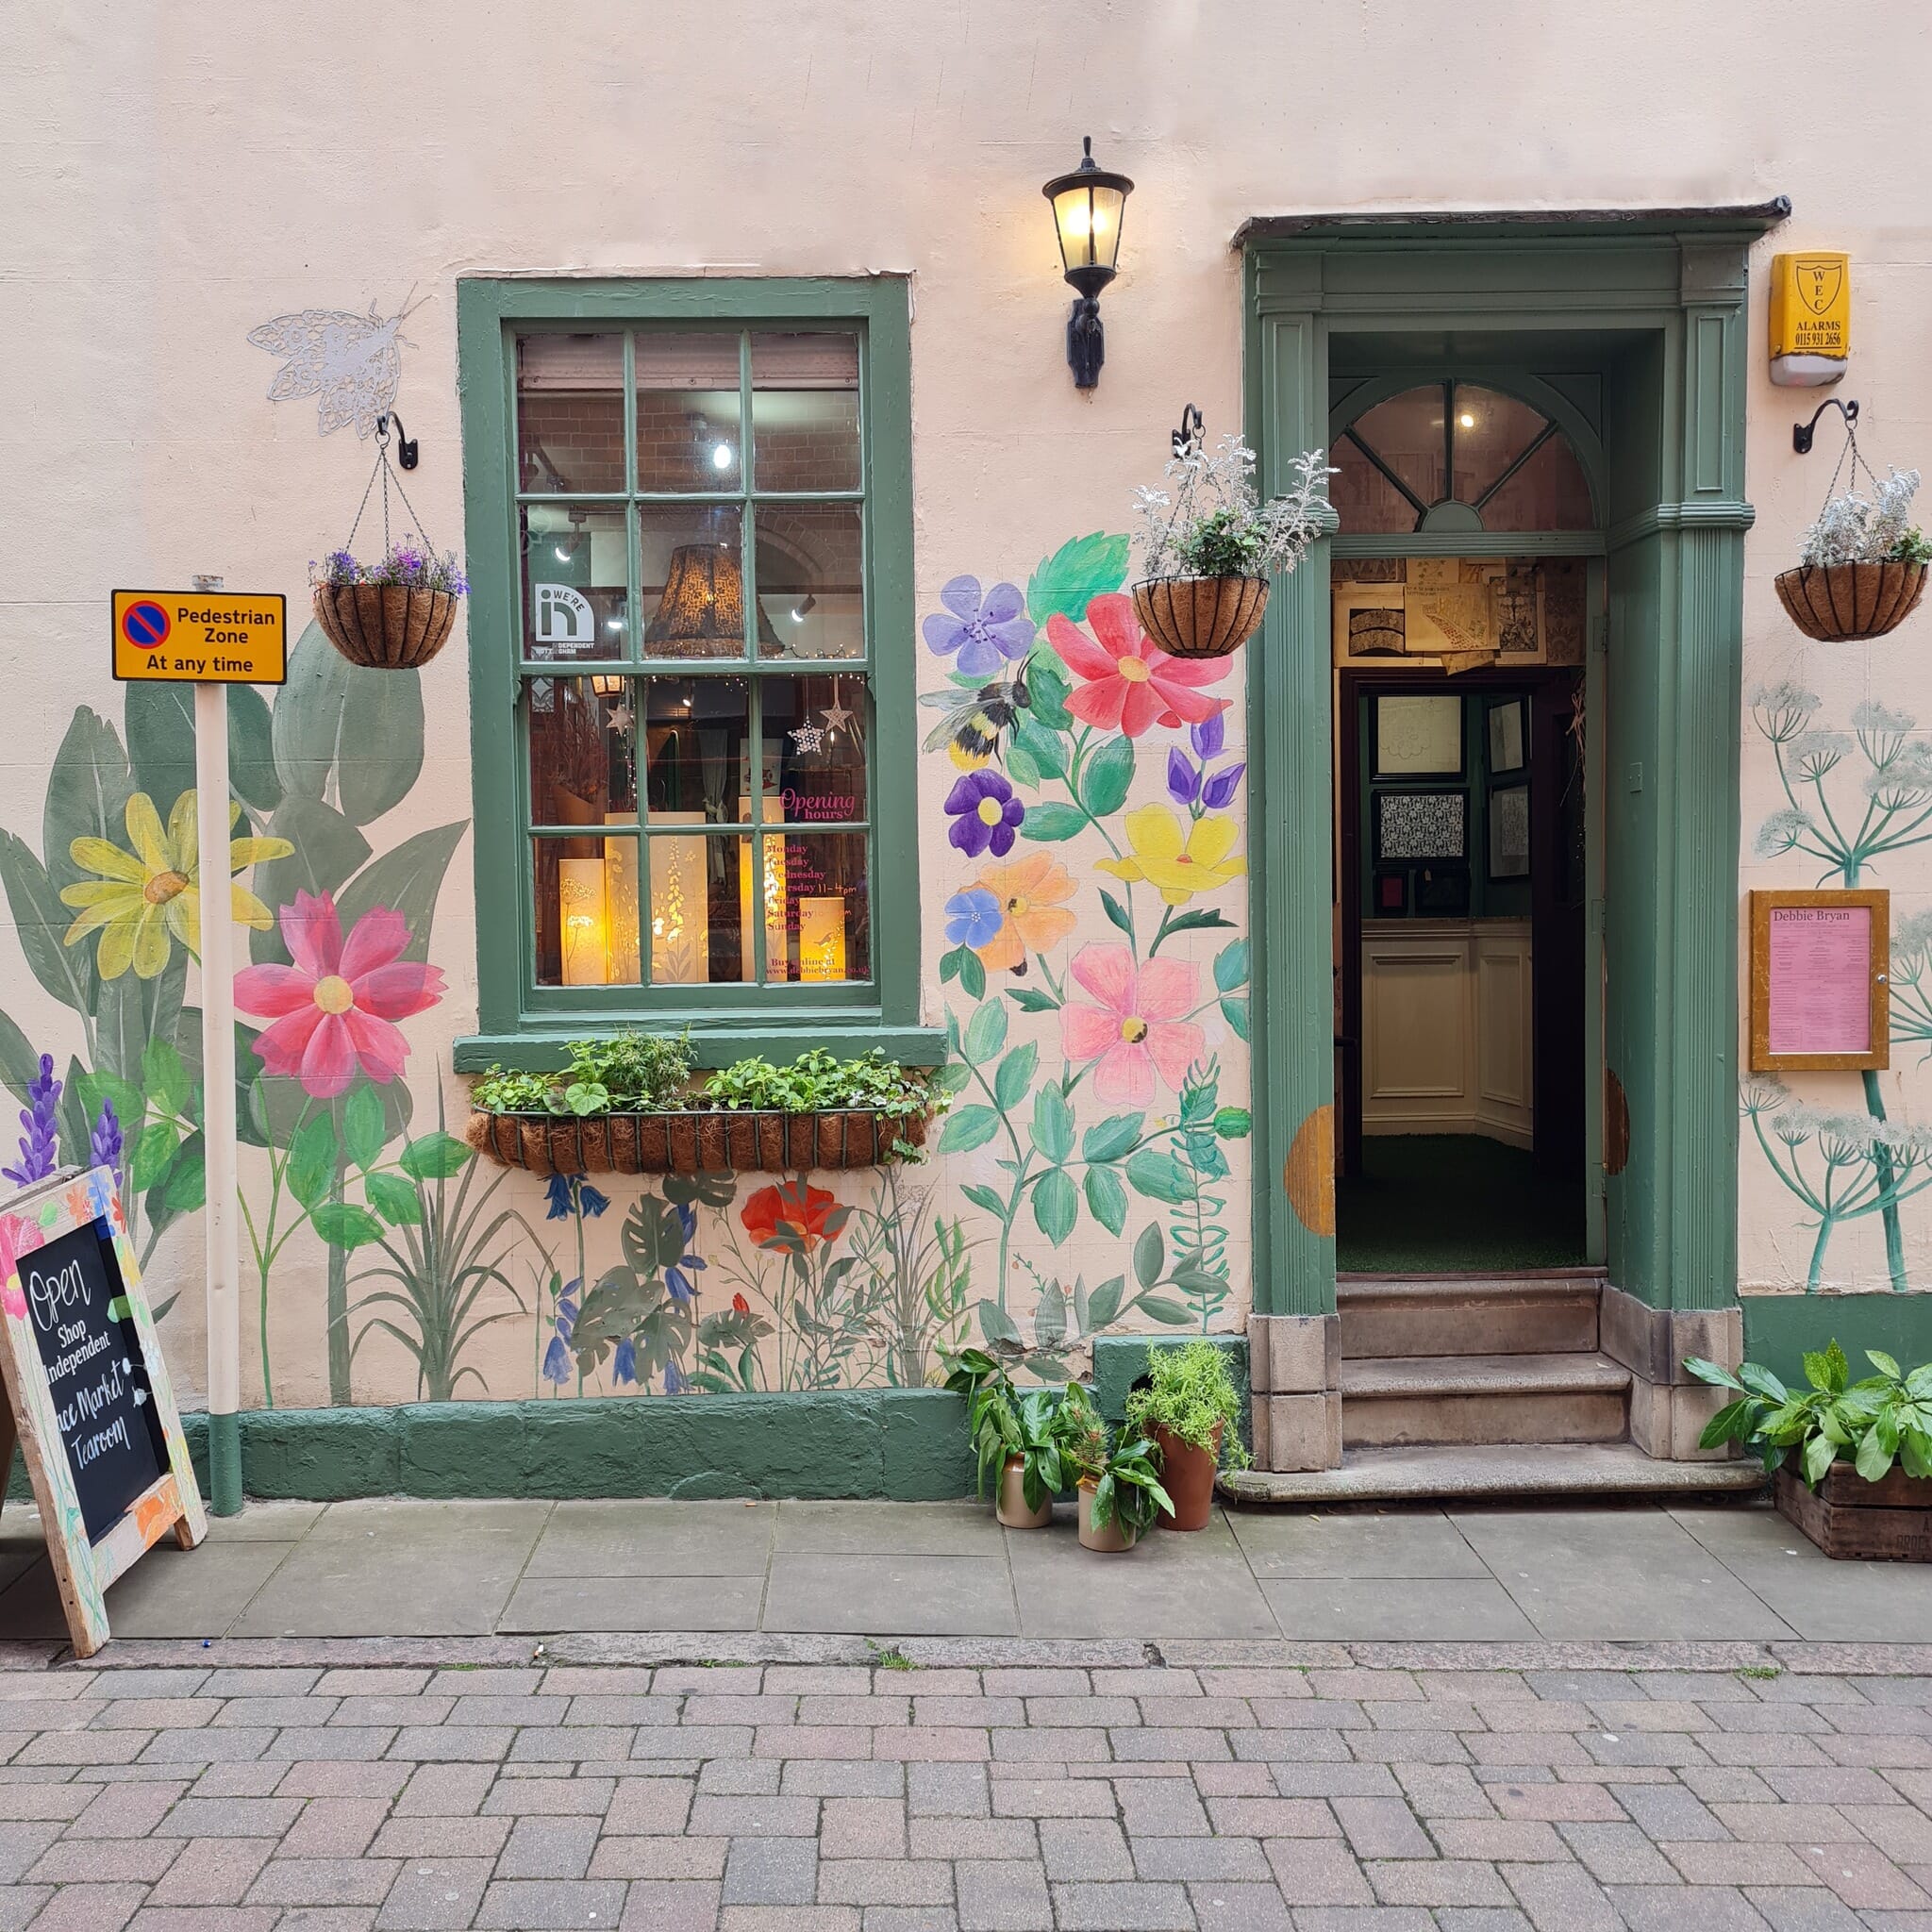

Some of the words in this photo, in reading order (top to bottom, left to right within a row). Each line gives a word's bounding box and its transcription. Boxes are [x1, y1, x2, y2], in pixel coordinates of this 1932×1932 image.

[1796, 321, 1840, 331] ALARMS
[1795, 333, 1809, 345] 0115
[1812, 333, 1824, 345] 931
[1825, 332, 1840, 345] 2656
[553, 590, 585, 612] WE'RE
[177, 608, 275, 625] Pedestrian
[541, 590, 577, 636] in
[205, 627, 248, 643] Zone
[146, 655, 167, 670] At
[175, 658, 206, 674] any
[212, 657, 253, 673] time
[779, 788, 855, 817] Opening
[805, 808, 843, 819] hours
[767, 844, 808, 855] Monday
[767, 908, 814, 919] Saturday
[1774, 910, 1813, 921] Debbie
[1817, 910, 1849, 923] Bryan
[767, 922, 806, 932] Sunday
[29, 1258, 92, 1331] Open
[58, 1319, 87, 1349] Shop
[57, 1403, 78, 1434] ace
[76, 1360, 125, 1421] Market
[71, 1415, 131, 1470] Tearoom
